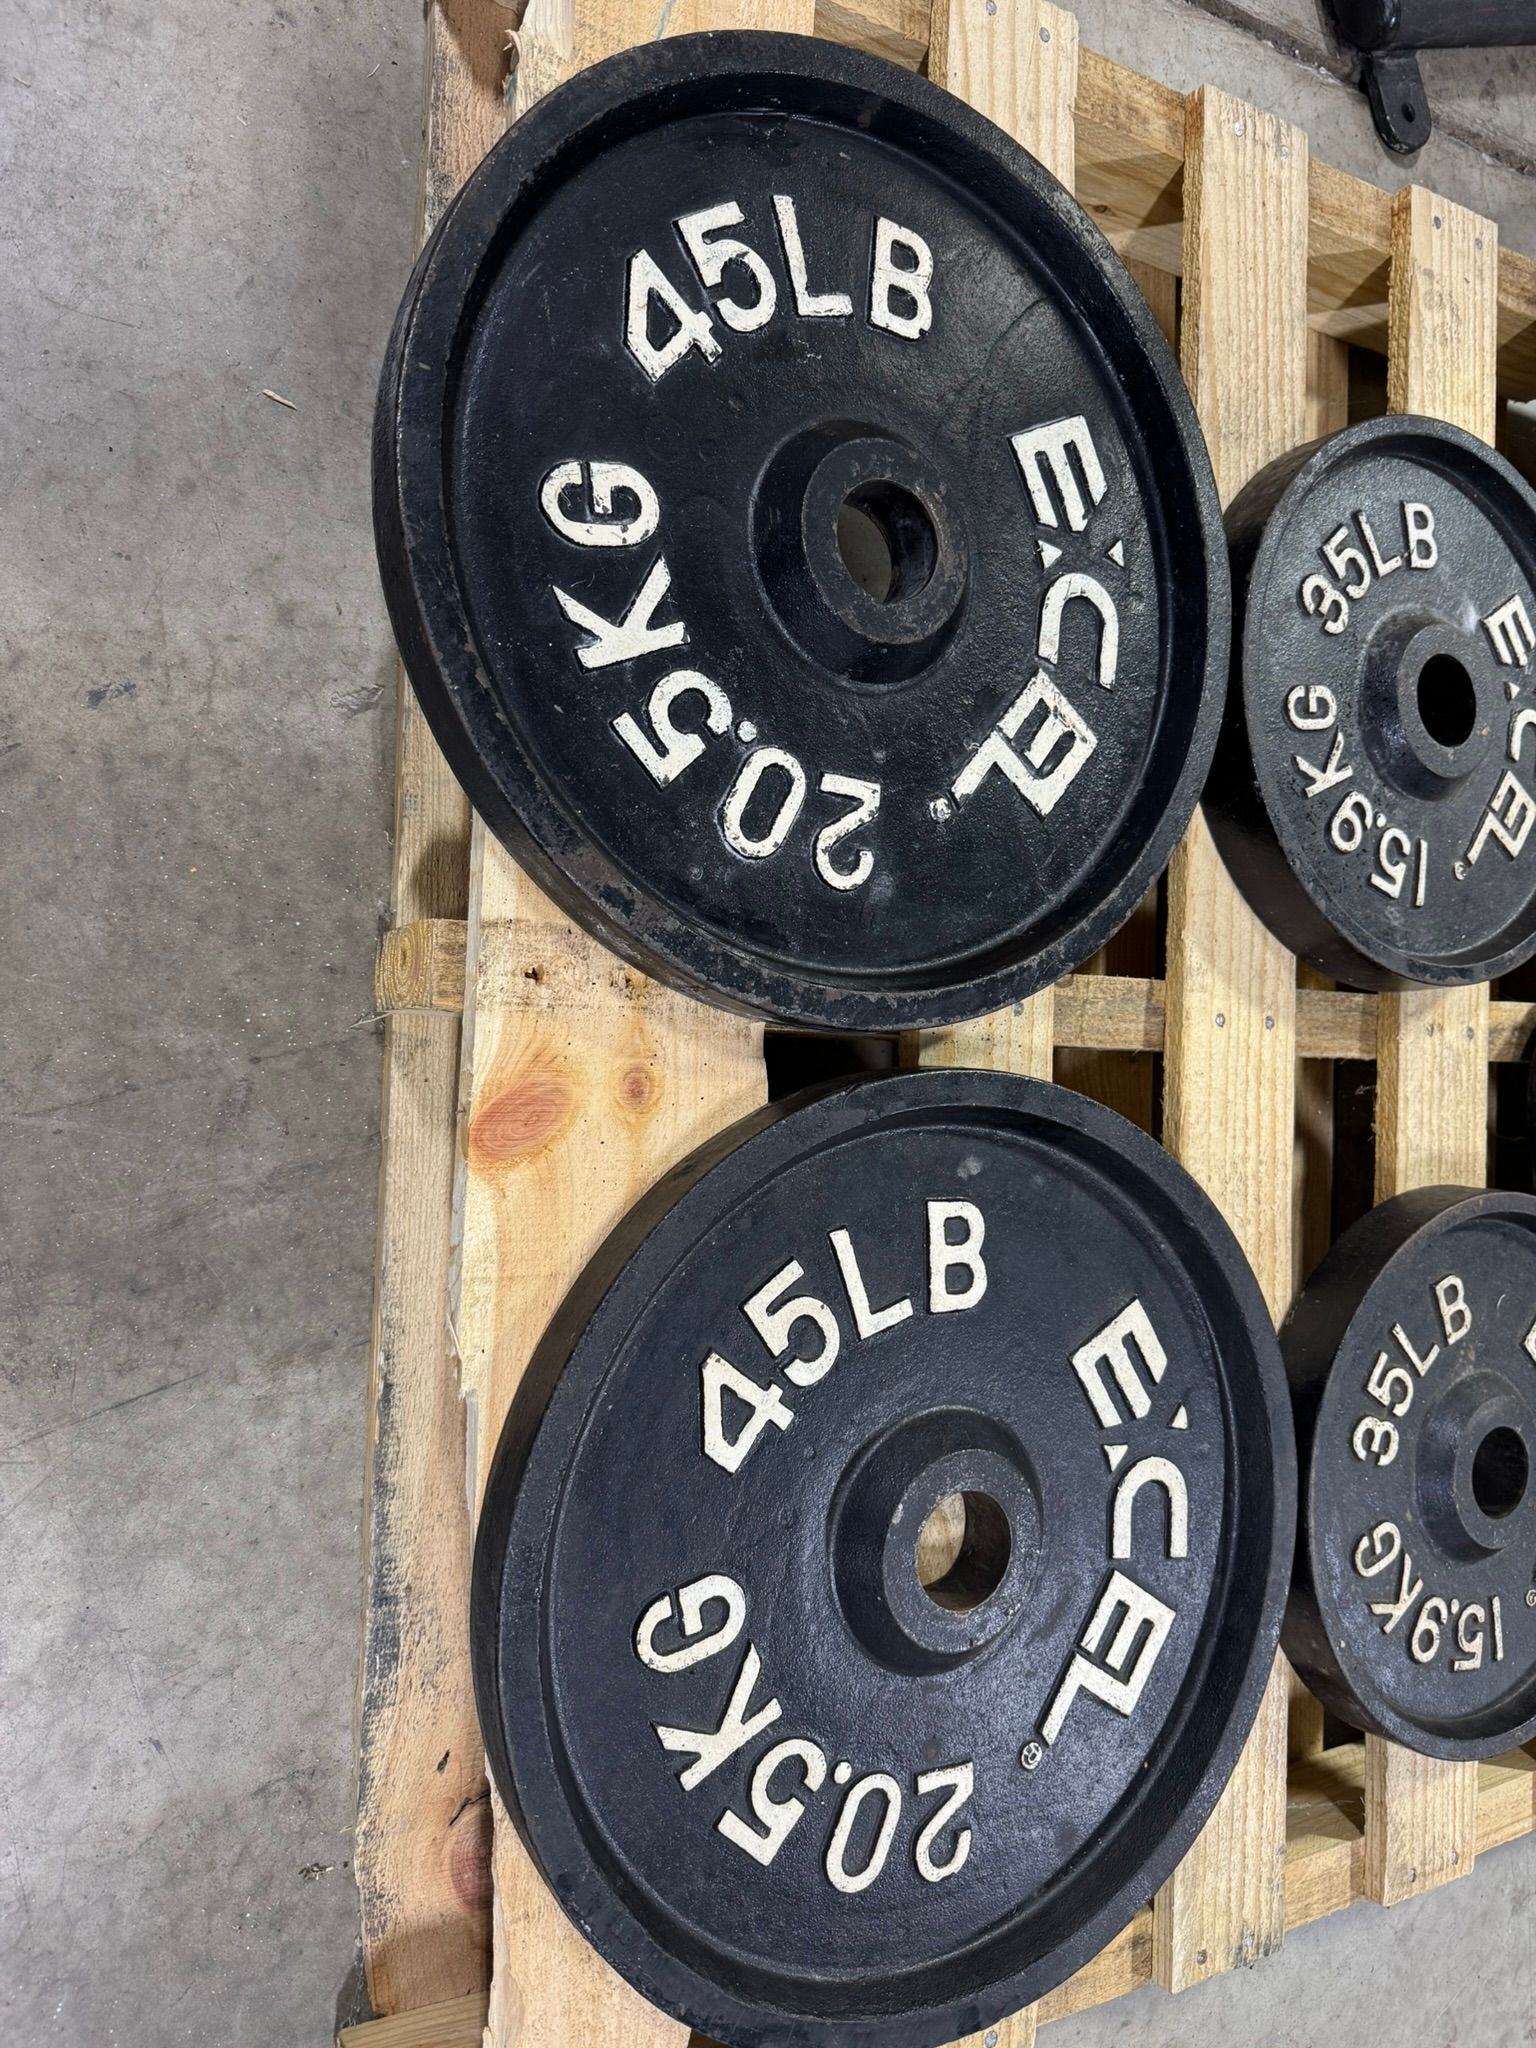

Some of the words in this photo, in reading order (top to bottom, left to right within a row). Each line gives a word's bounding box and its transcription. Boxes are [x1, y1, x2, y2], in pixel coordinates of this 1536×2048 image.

[627, 194, 934, 382] 45LB
[1302, 501, 1439, 635] 35LB
[702, 1201, 988, 1474] 45LB
[1352, 1274, 1473, 1467] 35LB
